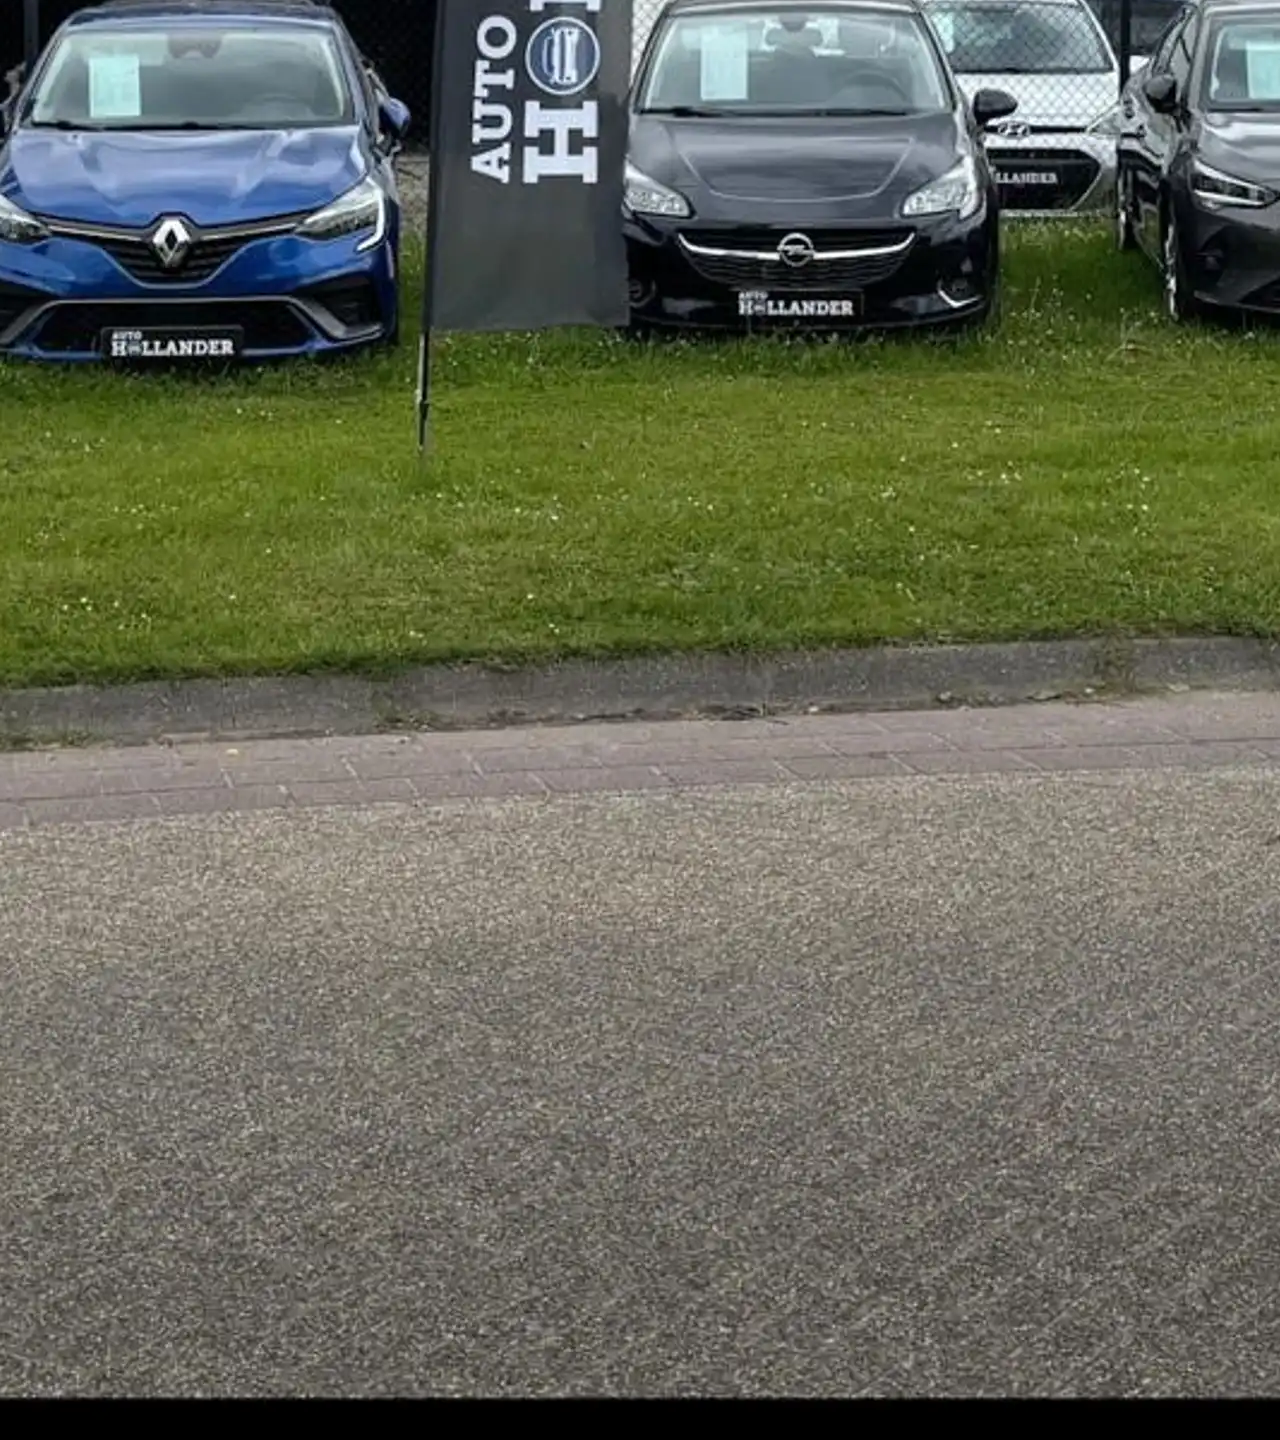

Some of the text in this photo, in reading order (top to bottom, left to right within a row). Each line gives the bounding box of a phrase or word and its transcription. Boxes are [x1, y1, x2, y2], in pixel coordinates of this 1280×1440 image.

[470, 14, 518, 184] AUTO
[738, 299, 854, 316] HOLLANDER
[112, 330, 143, 341] AUTO
[111, 339, 235, 357] HOLLANDER
